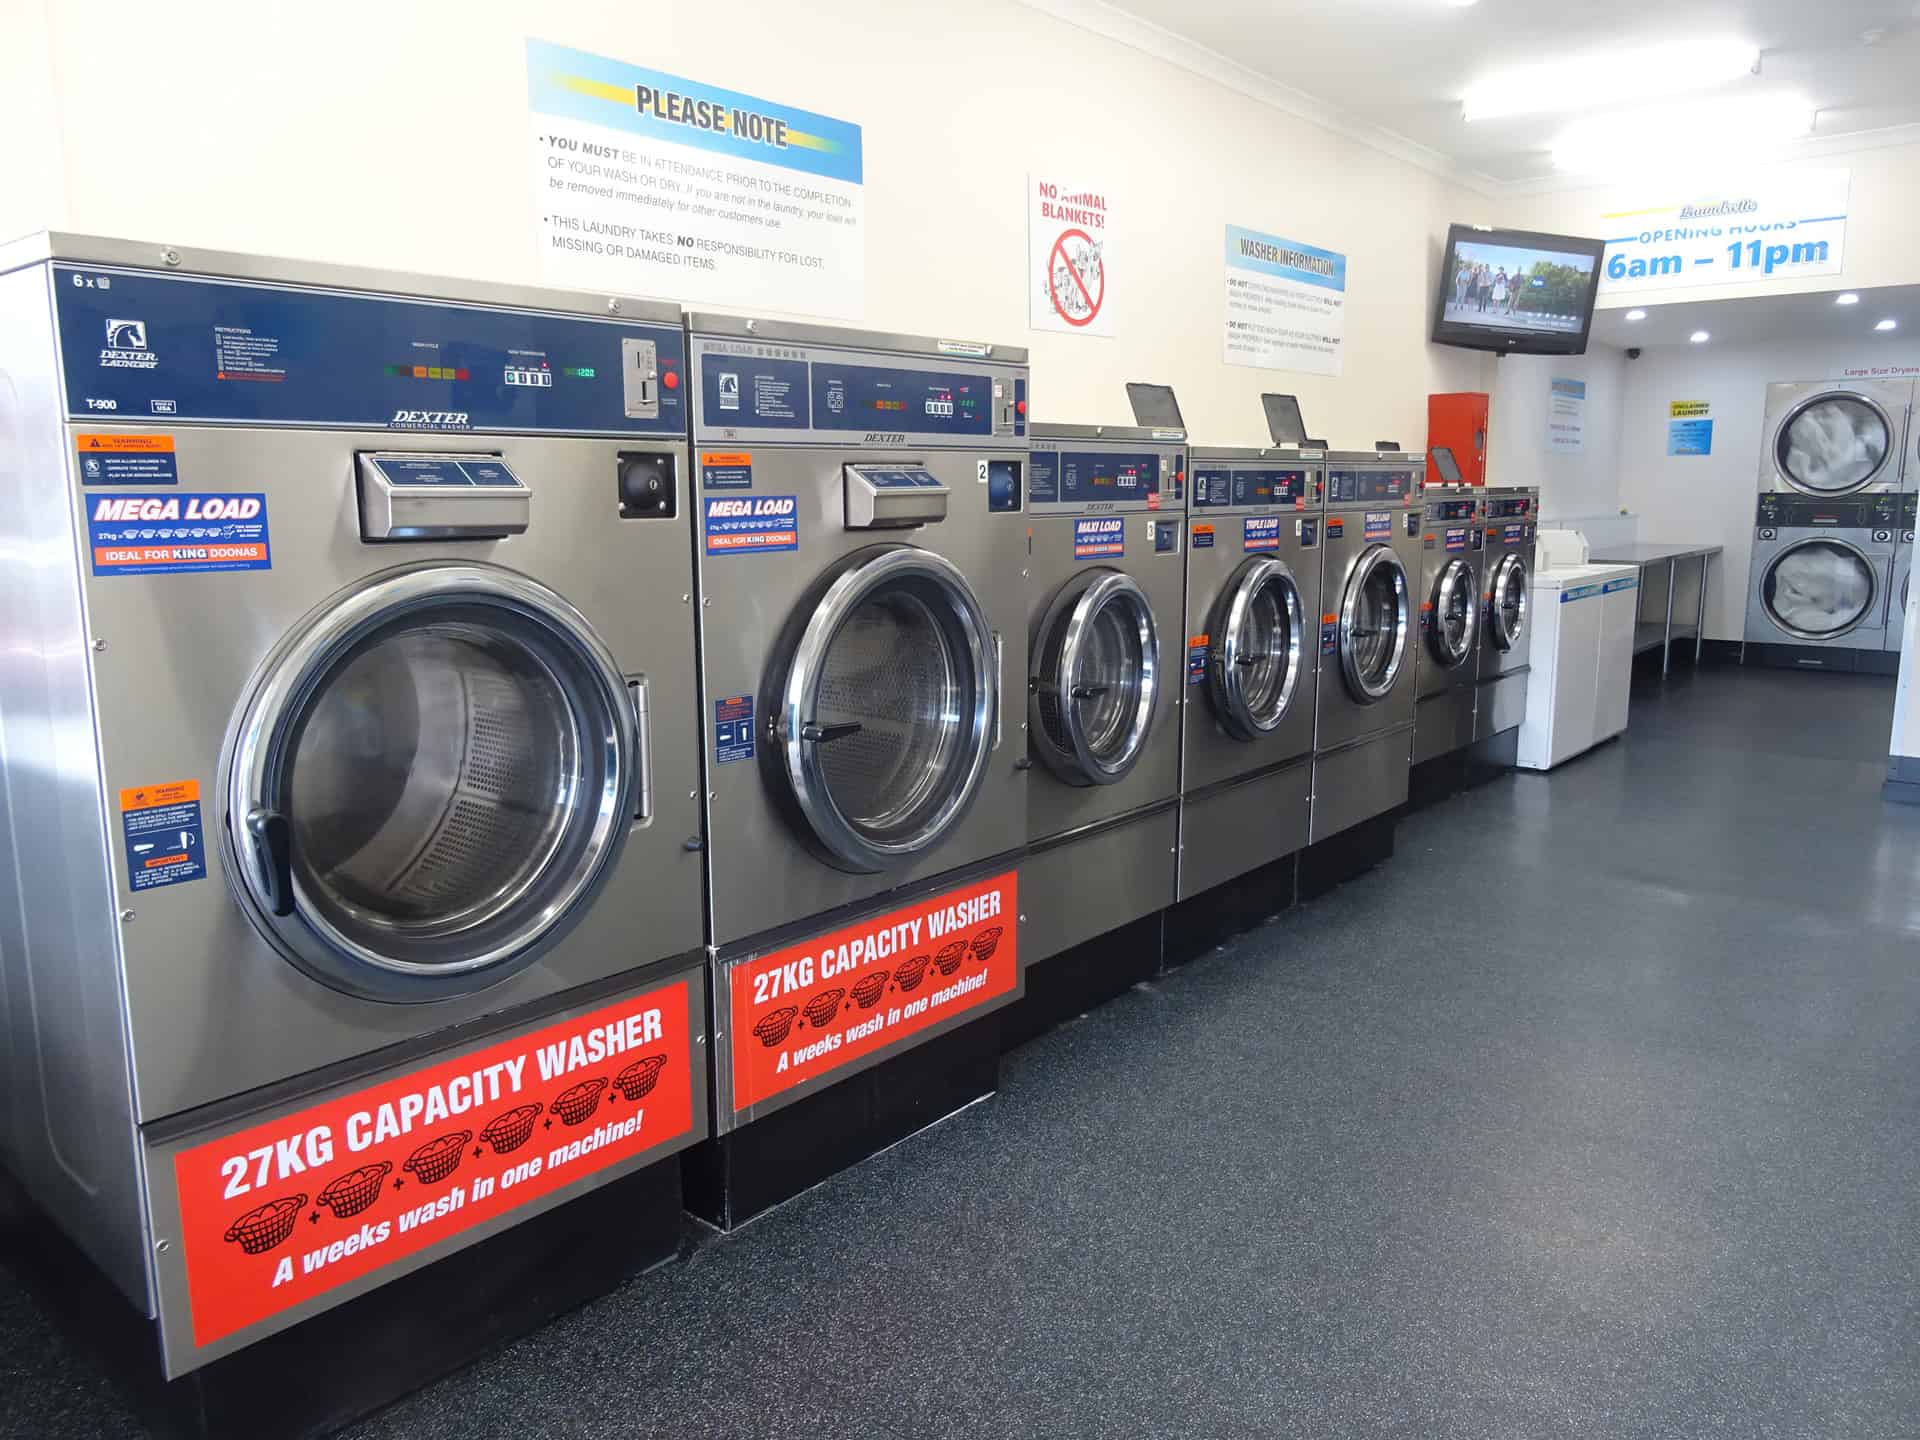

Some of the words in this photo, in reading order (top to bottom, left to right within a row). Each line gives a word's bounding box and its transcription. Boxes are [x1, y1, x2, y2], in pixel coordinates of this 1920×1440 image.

[635, 83, 726, 133] PLEASE
[732, 107, 788, 148] NOTE
[549, 135, 578, 151] YOU
[582, 142, 620, 160] MUST
[622, 151, 637, 164] BE
[655, 158, 723, 183] ATTENDANCE
[726, 172, 757, 189] PRIOR
[759, 179, 771, 193] TO
[773, 182, 791, 196] THE
[547, 156, 566, 169] OF
[568, 159, 600, 176] YOUR
[603, 167, 637, 184] WASH
[640, 174, 657, 187] OR
[695, 188, 711, 200] you
[1039, 181, 1057, 199] NO
[549, 176, 563, 189] be
[567, 182, 613, 199] removed
[615, 191, 674, 211] immediately
[677, 200, 690, 212] for
[691, 203, 717, 217] other
[718, 209, 764, 226] customers
[1042, 201, 1104, 229] BLANKETS!
[551, 215, 579, 231] THIS
[582, 219, 637, 239] LAUNDRY
[639, 229, 674, 246] TAKES
[676, 235, 695, 248] NO
[696, 238, 777, 261] RESPONSIBILITY
[778, 251, 798, 265] FOR
[1639, 224, 1722, 244] OPENING
[552, 235, 602, 254] MISSING
[606, 243, 624, 257] OR
[626, 245, 681, 267] DAMAGED
[1240, 236, 1277, 263] WASHER
[1280, 248, 1335, 276] INFORMATION
[1607, 253, 1683, 280] 6am
[1727, 239, 1829, 274] 11pm
[73, 274, 83, 288] 6
[86, 278, 94, 288] x
[100, 359, 158, 369] LAUNDRY
[86, 398, 117, 410] T-900
[1672, 408, 1710, 417] LAUNDRY
[393, 411, 469, 425] DEXTER
[864, 433, 905, 443] DEXTER
[979, 463, 987, 479] 2
[93, 498, 180, 521] MEGA
[185, 497, 261, 520] LOAD
[709, 501, 752, 517] MEGA
[754, 499, 794, 516] LOAD
[1078, 521, 1099, 533] MAXI
[1100, 520, 1121, 532] LOAD
[746, 535, 765, 544] KING
[105, 551, 141, 561] IDEAL
[145, 550, 169, 560] FOR
[172, 548, 208, 559] KING
[210, 547, 258, 558] DOONAS
[752, 956, 815, 1006] 27KG
[820, 918, 922, 980] CAPACITY
[928, 890, 1001, 940] WASHER
[775, 1052, 789, 1075] A
[793, 1030, 842, 1066] weeks
[846, 1012, 885, 1045] wash
[887, 1006, 901, 1028] in
[903, 996, 928, 1020] one
[930, 967, 988, 1008] machine!
[219, 1125, 335, 1201] 27KG
[346, 1054, 529, 1153] CAPACITY
[536, 1007, 663, 1082] WASHER
[271, 1255, 293, 1289] A
[303, 1218, 392, 1275] weeks
[398, 1190, 465, 1234] wash
[471, 1173, 495, 1203] in
[500, 1158, 542, 1190] one
[547, 1108, 644, 1171] machine!
